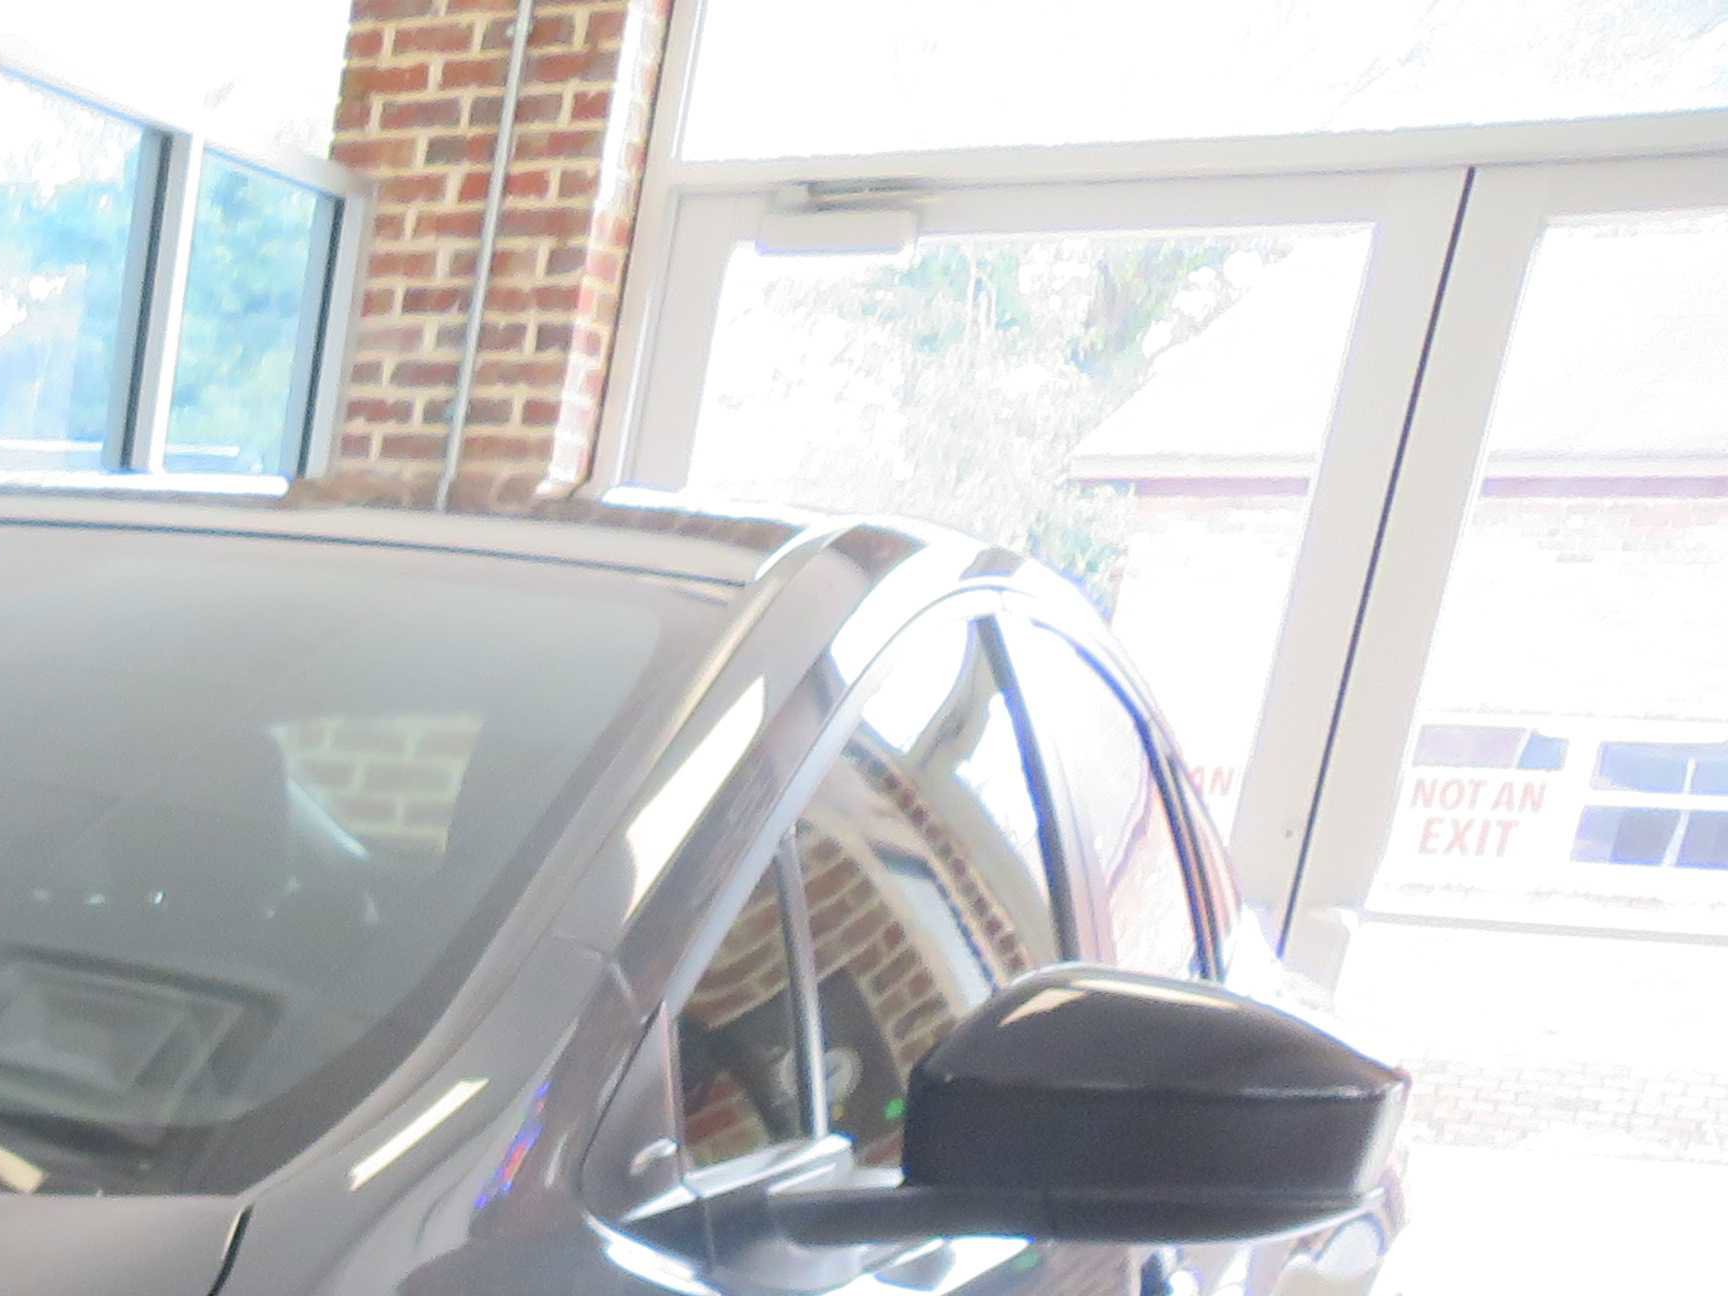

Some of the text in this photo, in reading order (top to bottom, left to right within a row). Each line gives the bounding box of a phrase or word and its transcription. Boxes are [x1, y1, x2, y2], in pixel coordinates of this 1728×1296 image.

[1410, 778, 1547, 812] NOT AN
[1417, 817, 1520, 857] EXIT
